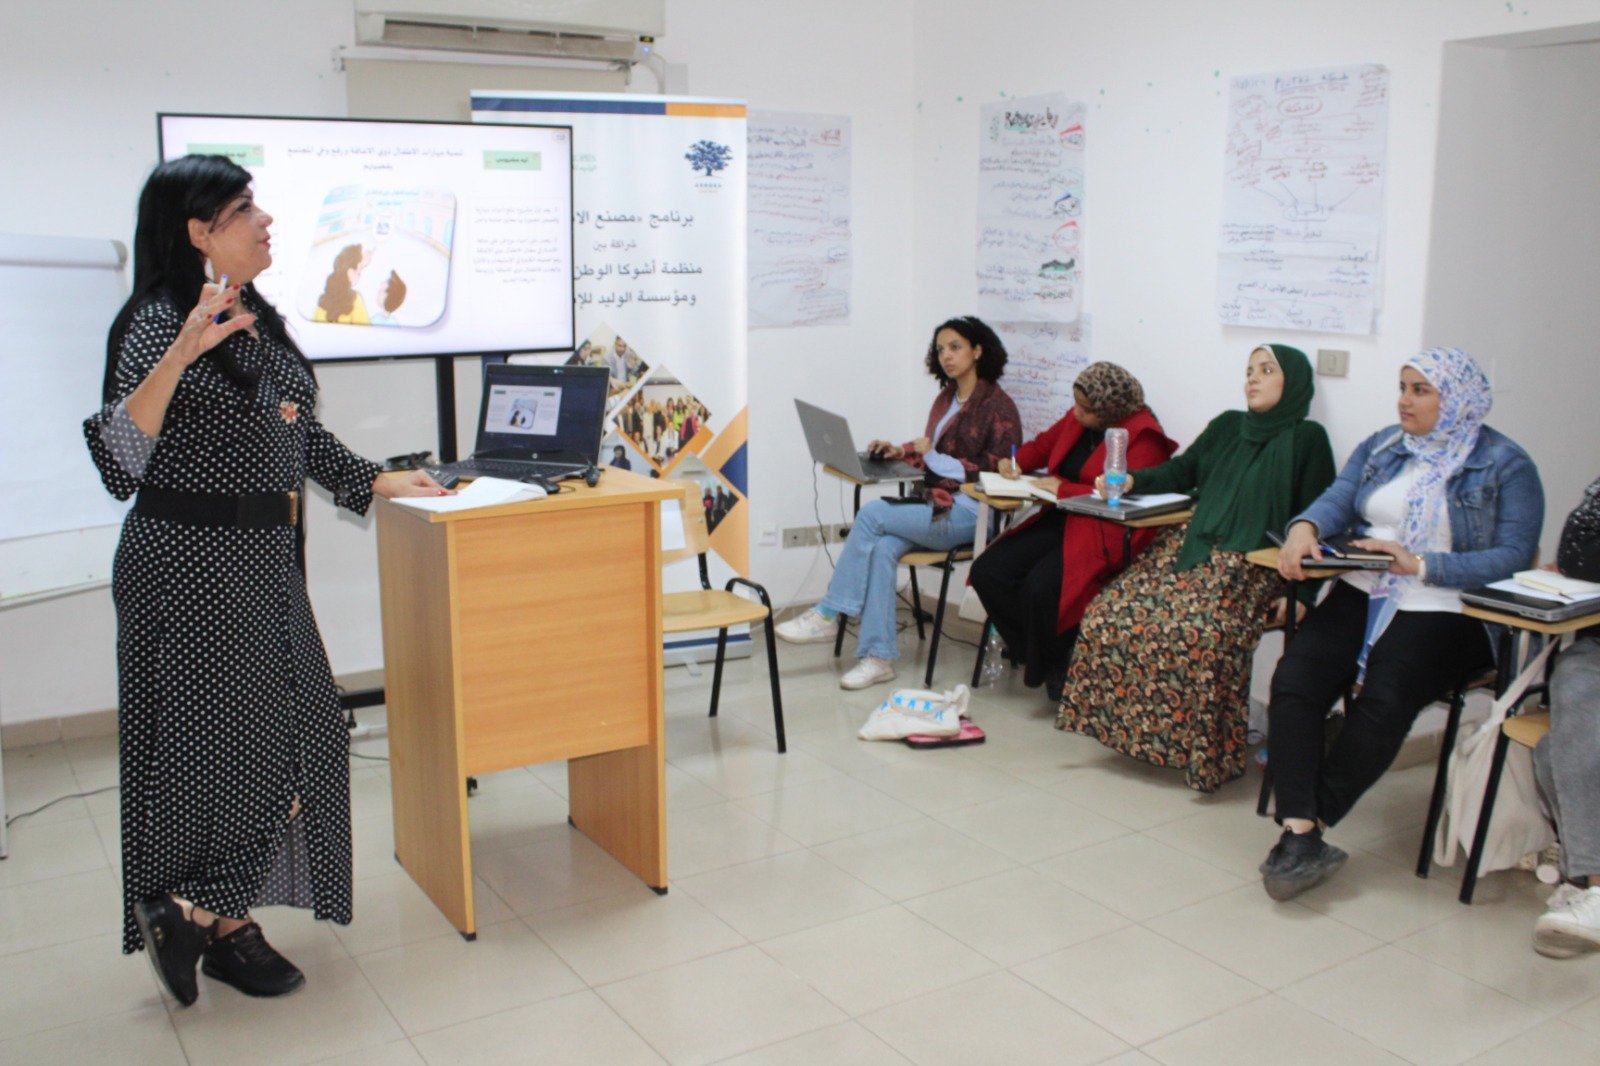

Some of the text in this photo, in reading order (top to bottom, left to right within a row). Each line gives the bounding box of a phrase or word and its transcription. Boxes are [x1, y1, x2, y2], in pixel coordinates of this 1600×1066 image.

[648, 209, 694, 229] برنامج
[592, 239, 637, 252] شراكة بين
[617, 259, 657, 280] أشوكا
[660, 261, 704, 275] منظمة
[597, 291, 633, 308] الوليد
[636, 290, 697, 307] ومؤسسة
